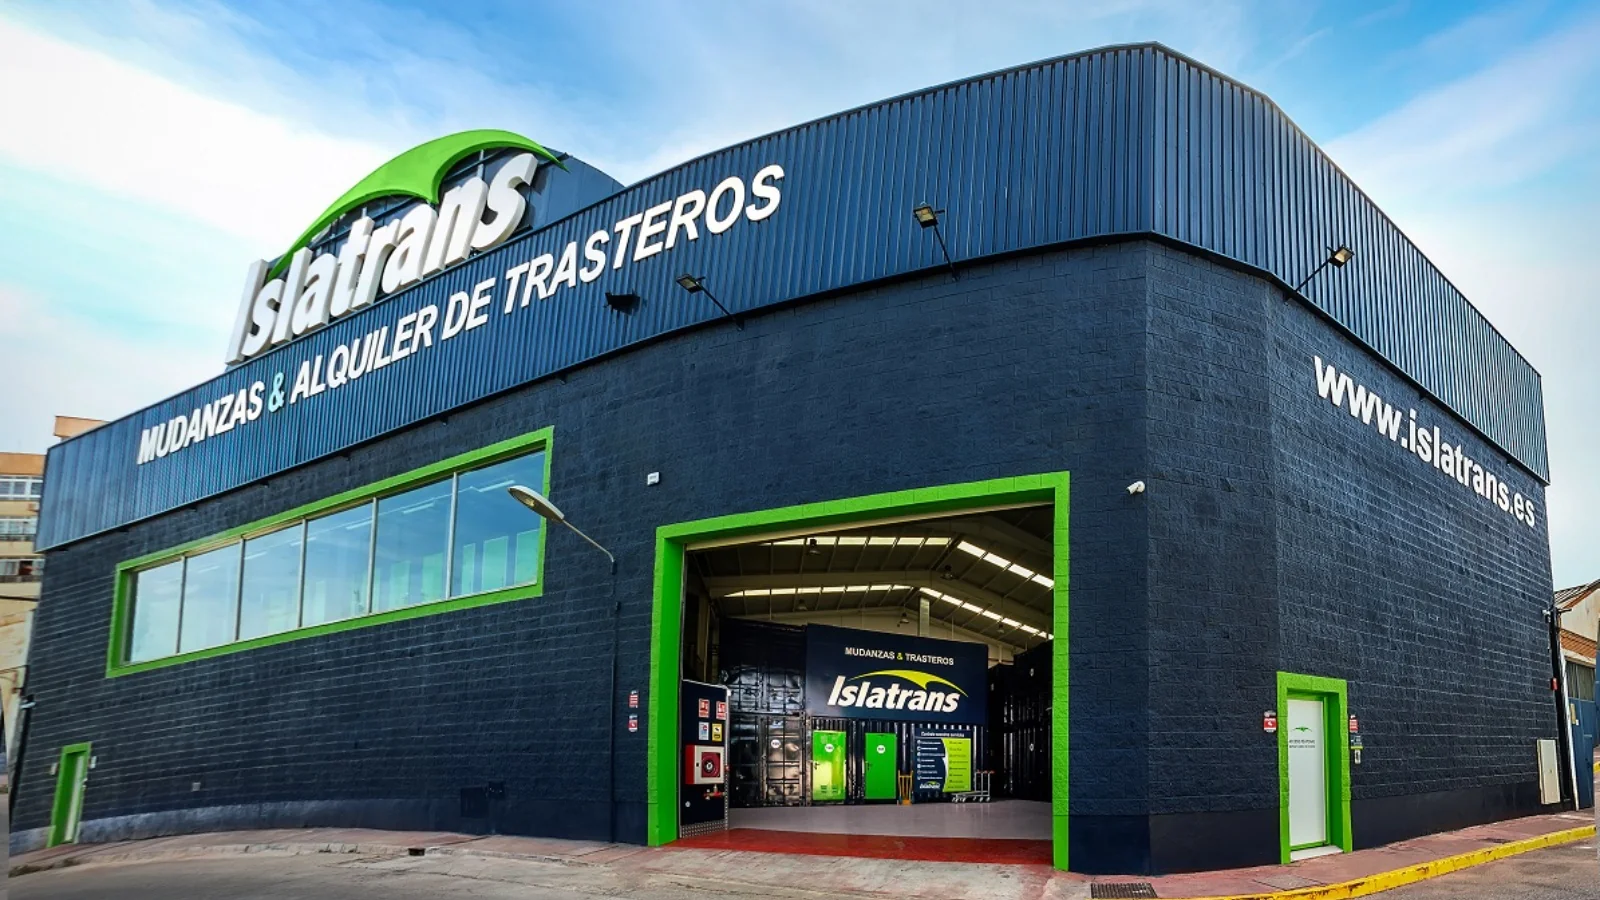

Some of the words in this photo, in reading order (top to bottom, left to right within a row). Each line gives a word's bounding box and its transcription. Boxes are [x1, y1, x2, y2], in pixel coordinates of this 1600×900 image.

[137, 380, 265, 464] MUDANZAS
[267, 372, 285, 413] &
[290, 304, 438, 404] ALQUILER
[441, 277, 497, 341] DE
[504, 164, 785, 314] TRASTEROS
[225, 153, 539, 366] Islatrans
[1314, 355, 1536, 527] www.islatrans.es
[827, 675, 960, 713] Islatrans
[844, 647, 895, 660] MUDANZAS
[896, 652, 903, 660] &
[905, 652, 954, 666] TRASTEROS
